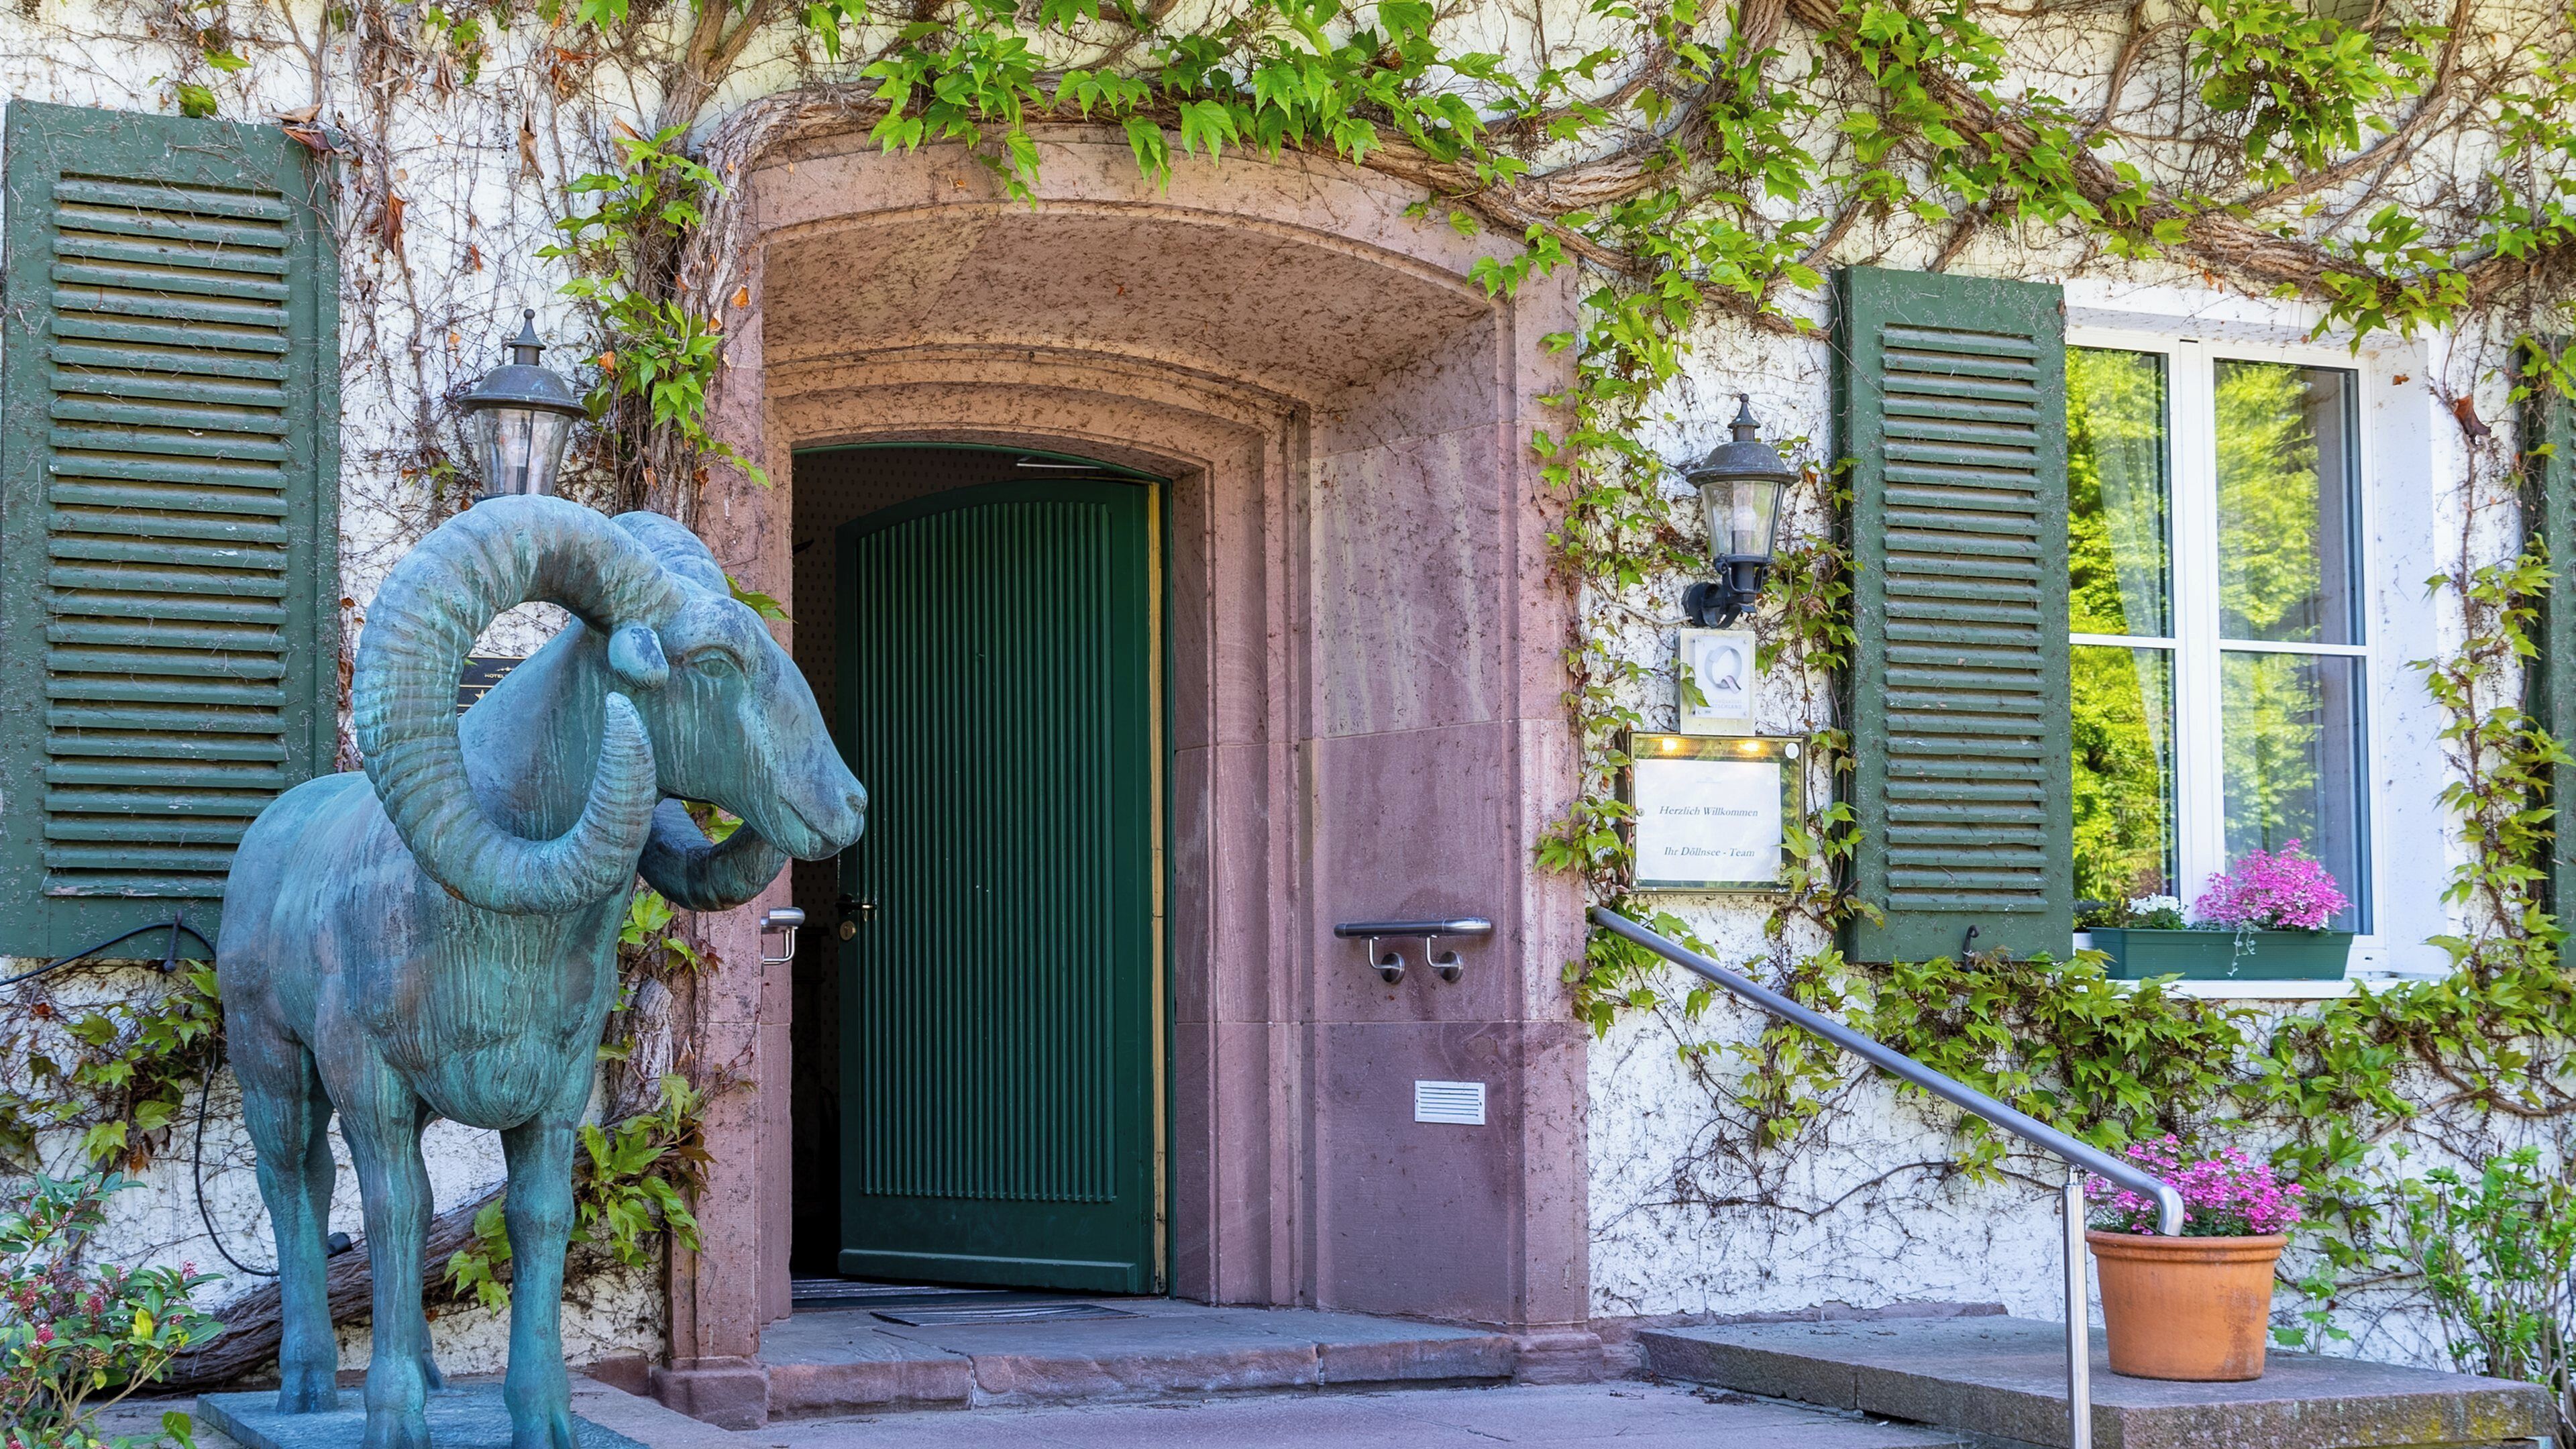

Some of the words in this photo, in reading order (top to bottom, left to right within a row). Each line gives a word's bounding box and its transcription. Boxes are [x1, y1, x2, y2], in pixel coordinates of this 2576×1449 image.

[1704, 645, 1742, 694] Q
[1659, 806, 1701, 815] Herzlich
[1703, 807, 1758, 817] Willkommen
[1664, 847, 1678, 856] Ihr
[1680, 847, 1721, 856] Döllnsee
[1729, 848, 1755, 857] Team
